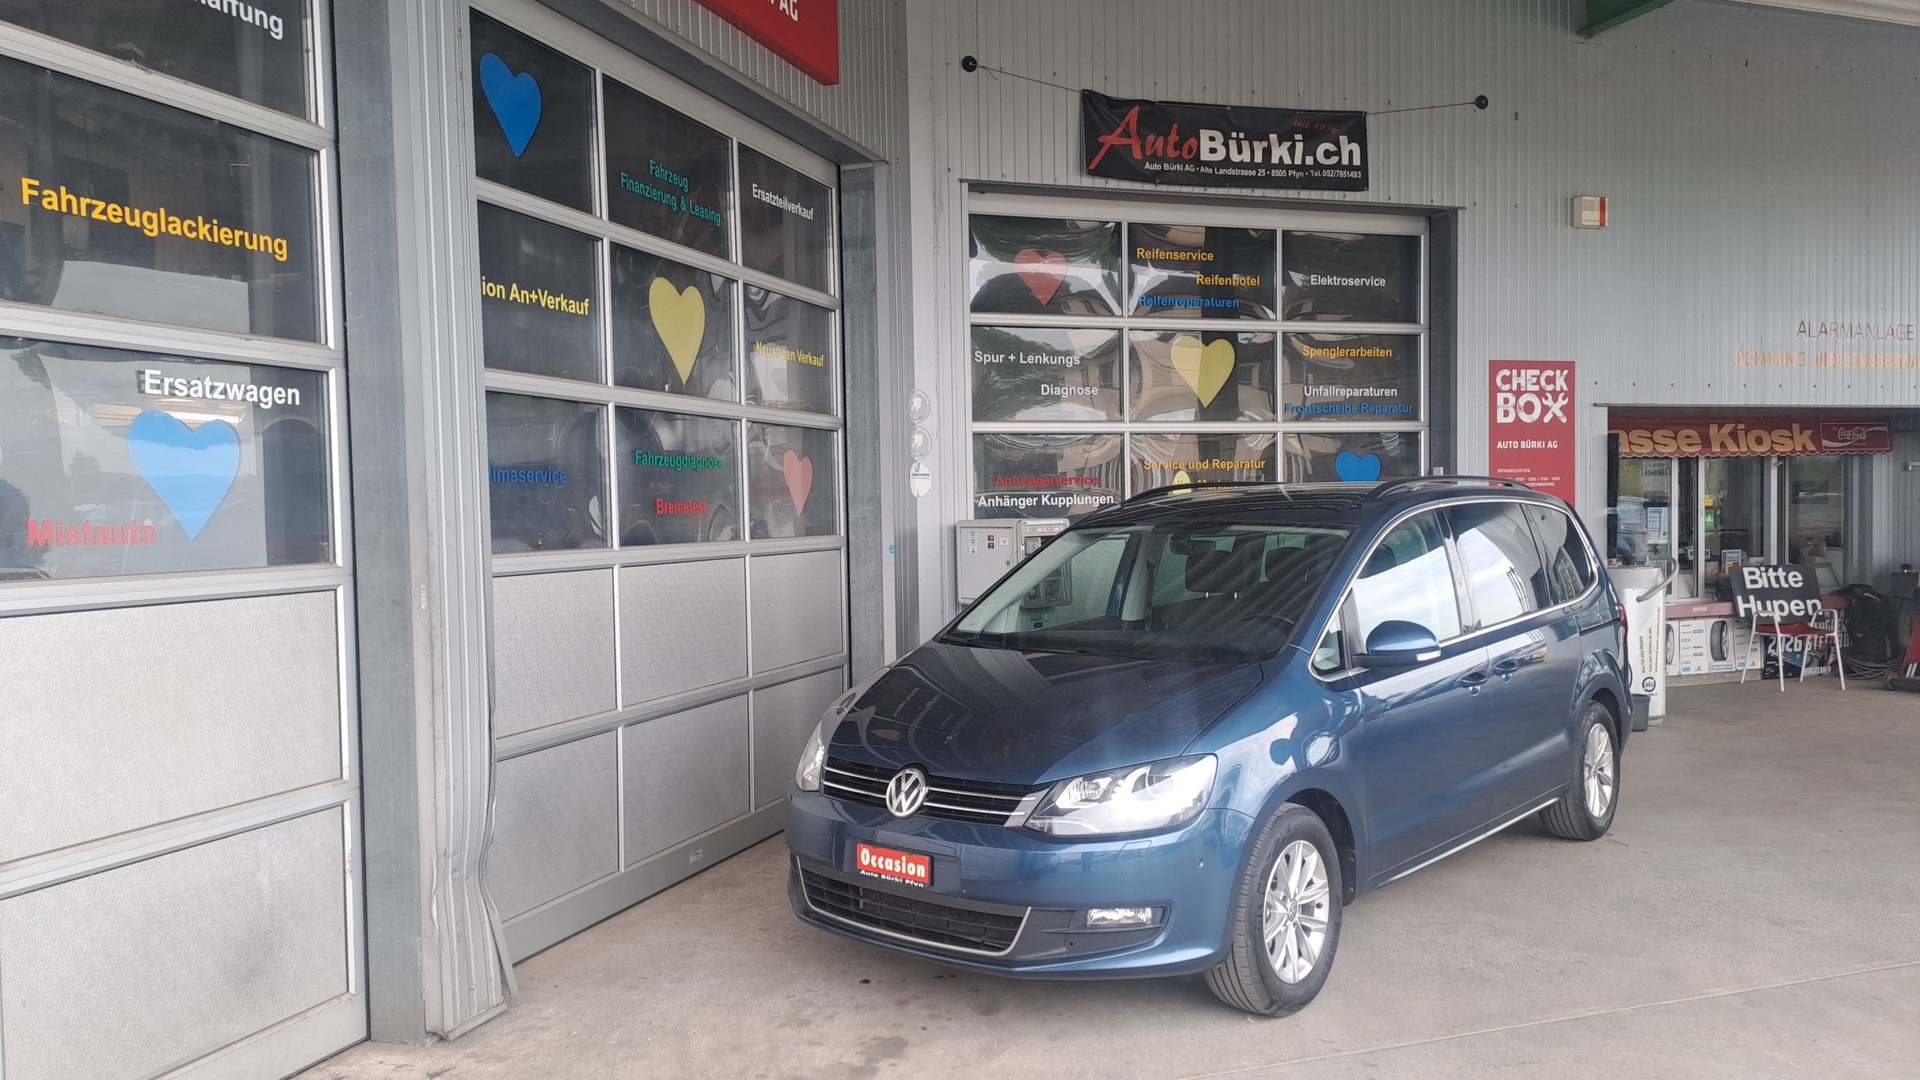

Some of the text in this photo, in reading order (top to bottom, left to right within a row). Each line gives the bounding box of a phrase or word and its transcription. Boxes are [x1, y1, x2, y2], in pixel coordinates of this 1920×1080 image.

[1313, 122, 1338, 134] 1976
[649, 160, 688, 193] Fahrzeug
[1144, 161, 1161, 171] Auto
[1163, 162, 1184, 172] Bürki
[1184, 164, 1195, 172] AG
[1200, 165, 1213, 174] Alte
[1214, 166, 1257, 176] Landstrasse
[1257, 169, 1266, 177] 25
[1271, 169, 1287, 178] 8505
[620, 171, 721, 227] Finanzierung & Leasing
[752, 183, 814, 220] Ersatzteilverkauf
[21, 177, 288, 262] Fahrzeuglackierung
[1136, 248, 1214, 261] Reifenservice
[1196, 274, 1260, 286] Reifenhotel
[1310, 274, 1386, 287] Elektroservice
[509, 283, 590, 316] An+Verkauf
[1138, 295, 1240, 308] Reifenreparaturen
[1797, 320, 1915, 341] ALARMANLAGE
[755, 340, 825, 368] Neuwagen Verkauf
[974, 350, 1080, 367] Spur + Lenkungs
[1302, 345, 1393, 359] Spenglerarbeiten
[144, 369, 300, 408] Ersatzwagen
[1496, 369, 1569, 391] CHECK
[1041, 384, 1098, 397] Diagnose
[1304, 385, 1398, 398] Unfallreparaturen
[1285, 402, 1413, 415] Frontscheibe Reparatur
[1496, 392, 1569, 424] BOX
[1497, 439, 1558, 449] AUTO BÜRKI AG
[1709, 423, 1817, 453] Kiosk
[635, 450, 725, 471] Fahrzeugdiagnose
[1143, 459, 1266, 471] Service und Reparatur
[994, 475, 1099, 490] Anhängerservice
[656, 498, 708, 515] Bremstest
[978, 494, 1114, 509] Anhänger Kupplungen
[27, 519, 158, 547] Mietauto
[1743, 566, 1803, 589] Bitte
[1737, 595, 1823, 623] Hupen
[860, 847, 926, 878] Occasion
[860, 869, 879, 878] Auto
